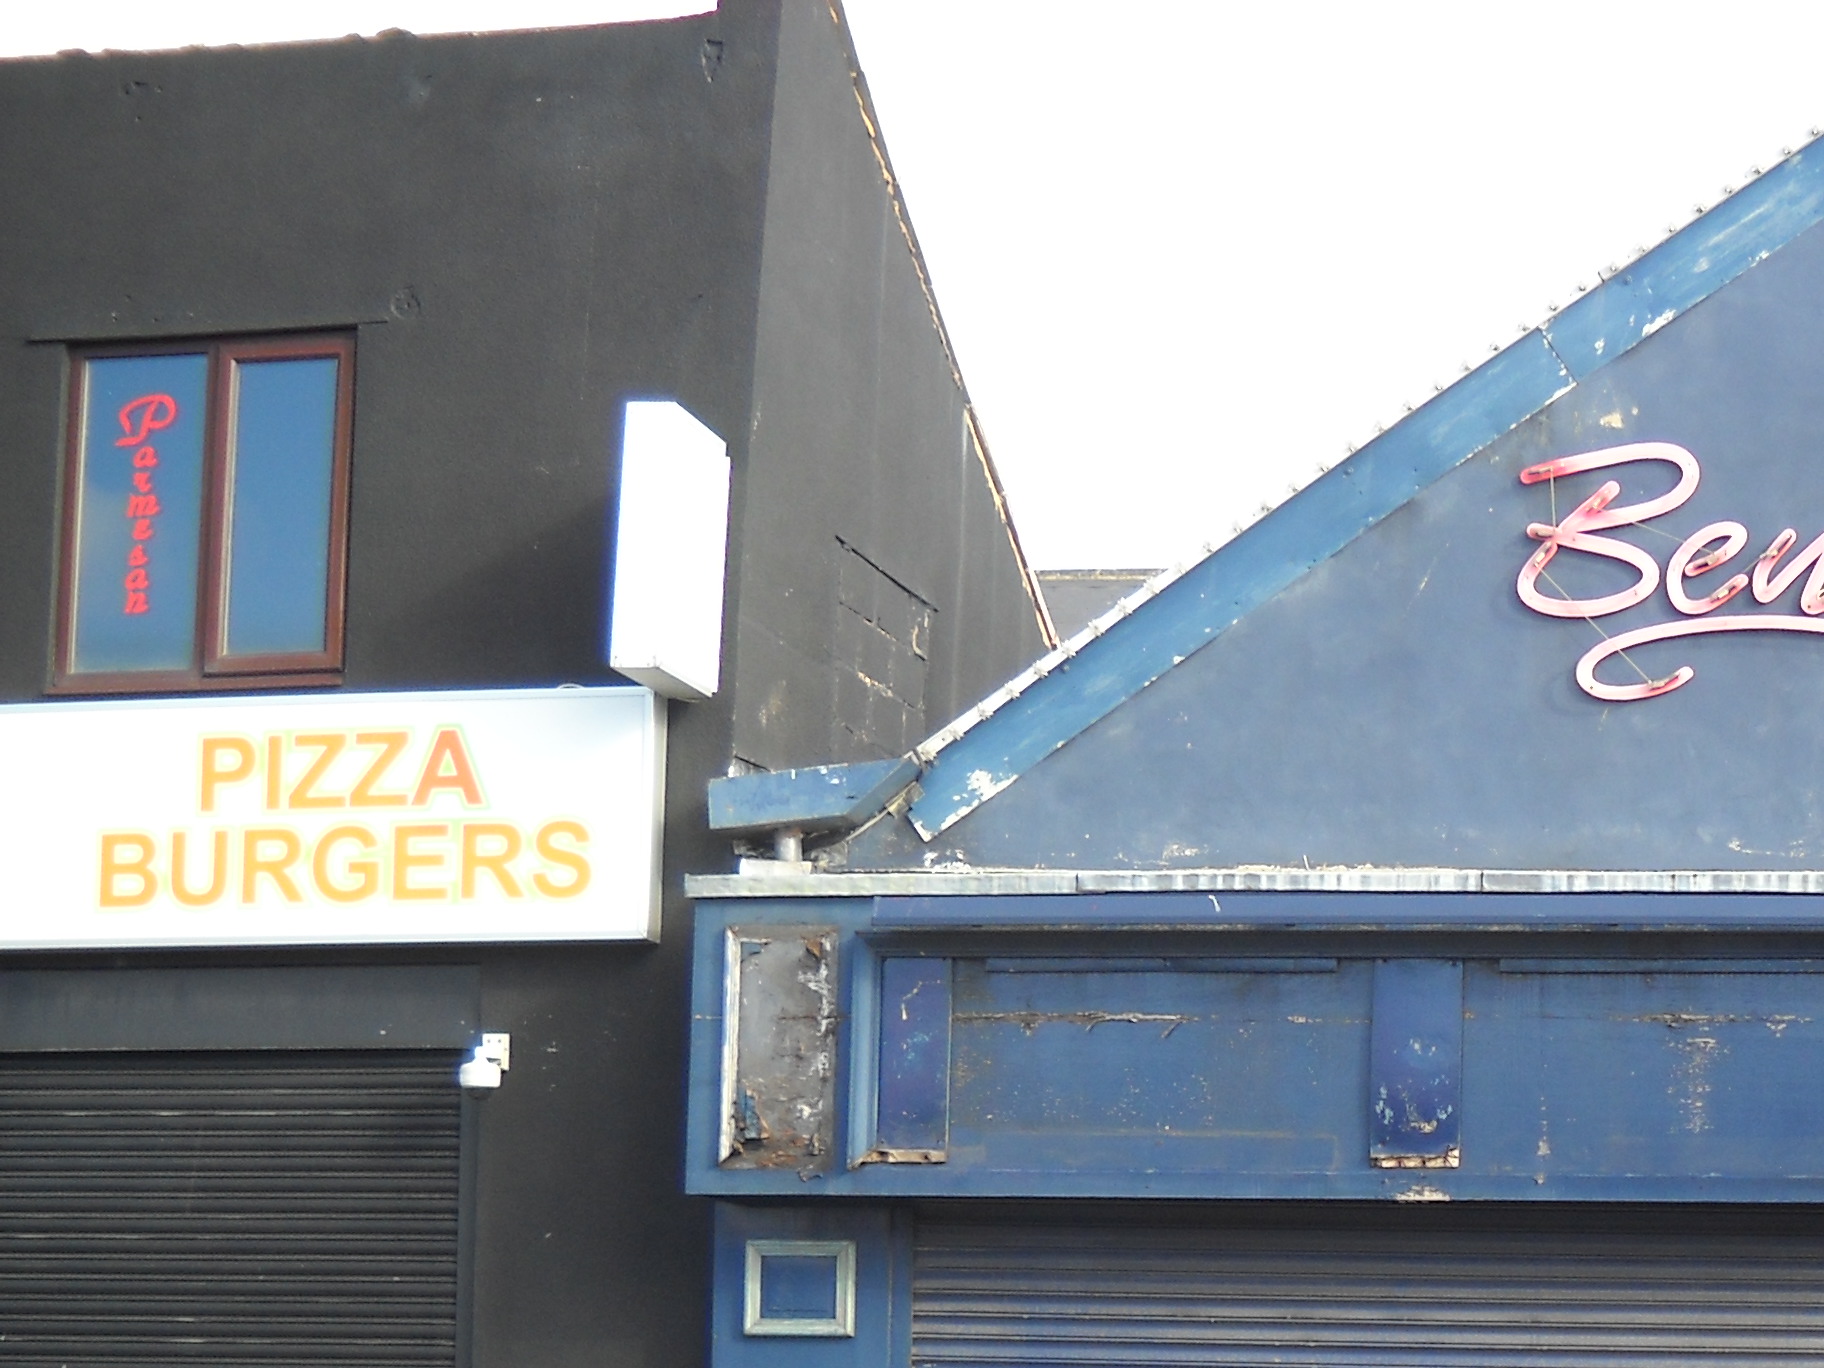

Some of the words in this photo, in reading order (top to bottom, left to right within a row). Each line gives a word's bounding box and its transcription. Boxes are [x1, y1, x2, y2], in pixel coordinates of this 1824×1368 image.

[114, 392, 178, 616] Parmesan
[200, 728, 483, 812] PIZZA
[98, 820, 592, 908] BURGERS
